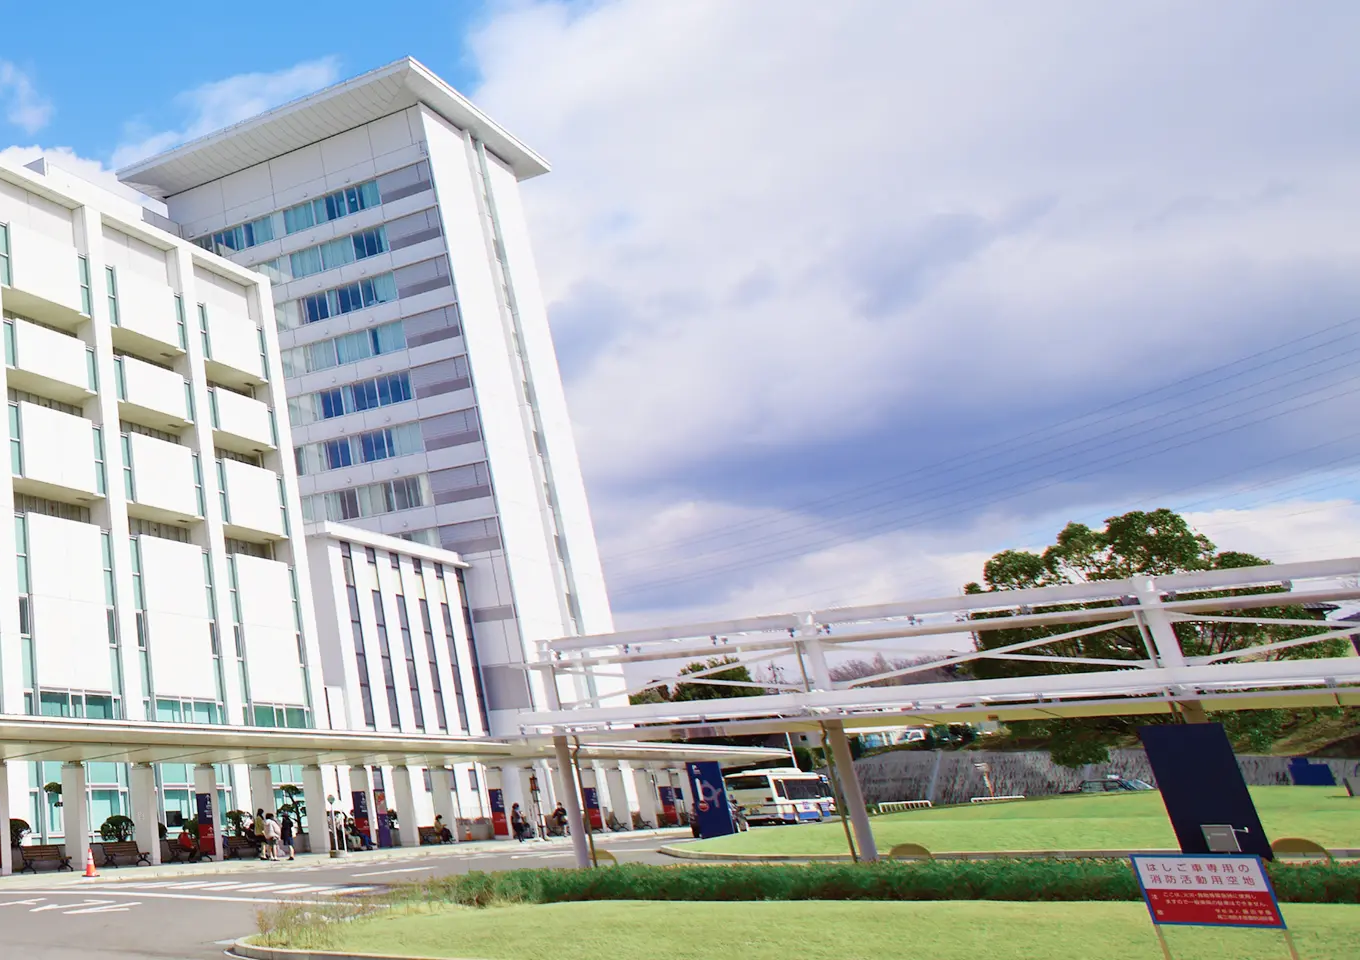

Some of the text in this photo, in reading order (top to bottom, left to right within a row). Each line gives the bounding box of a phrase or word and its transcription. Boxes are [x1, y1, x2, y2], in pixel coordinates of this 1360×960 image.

[1146, 863, 1249, 873] はしご車専用の
[1150, 875, 1255, 885] 消防活動用空地
